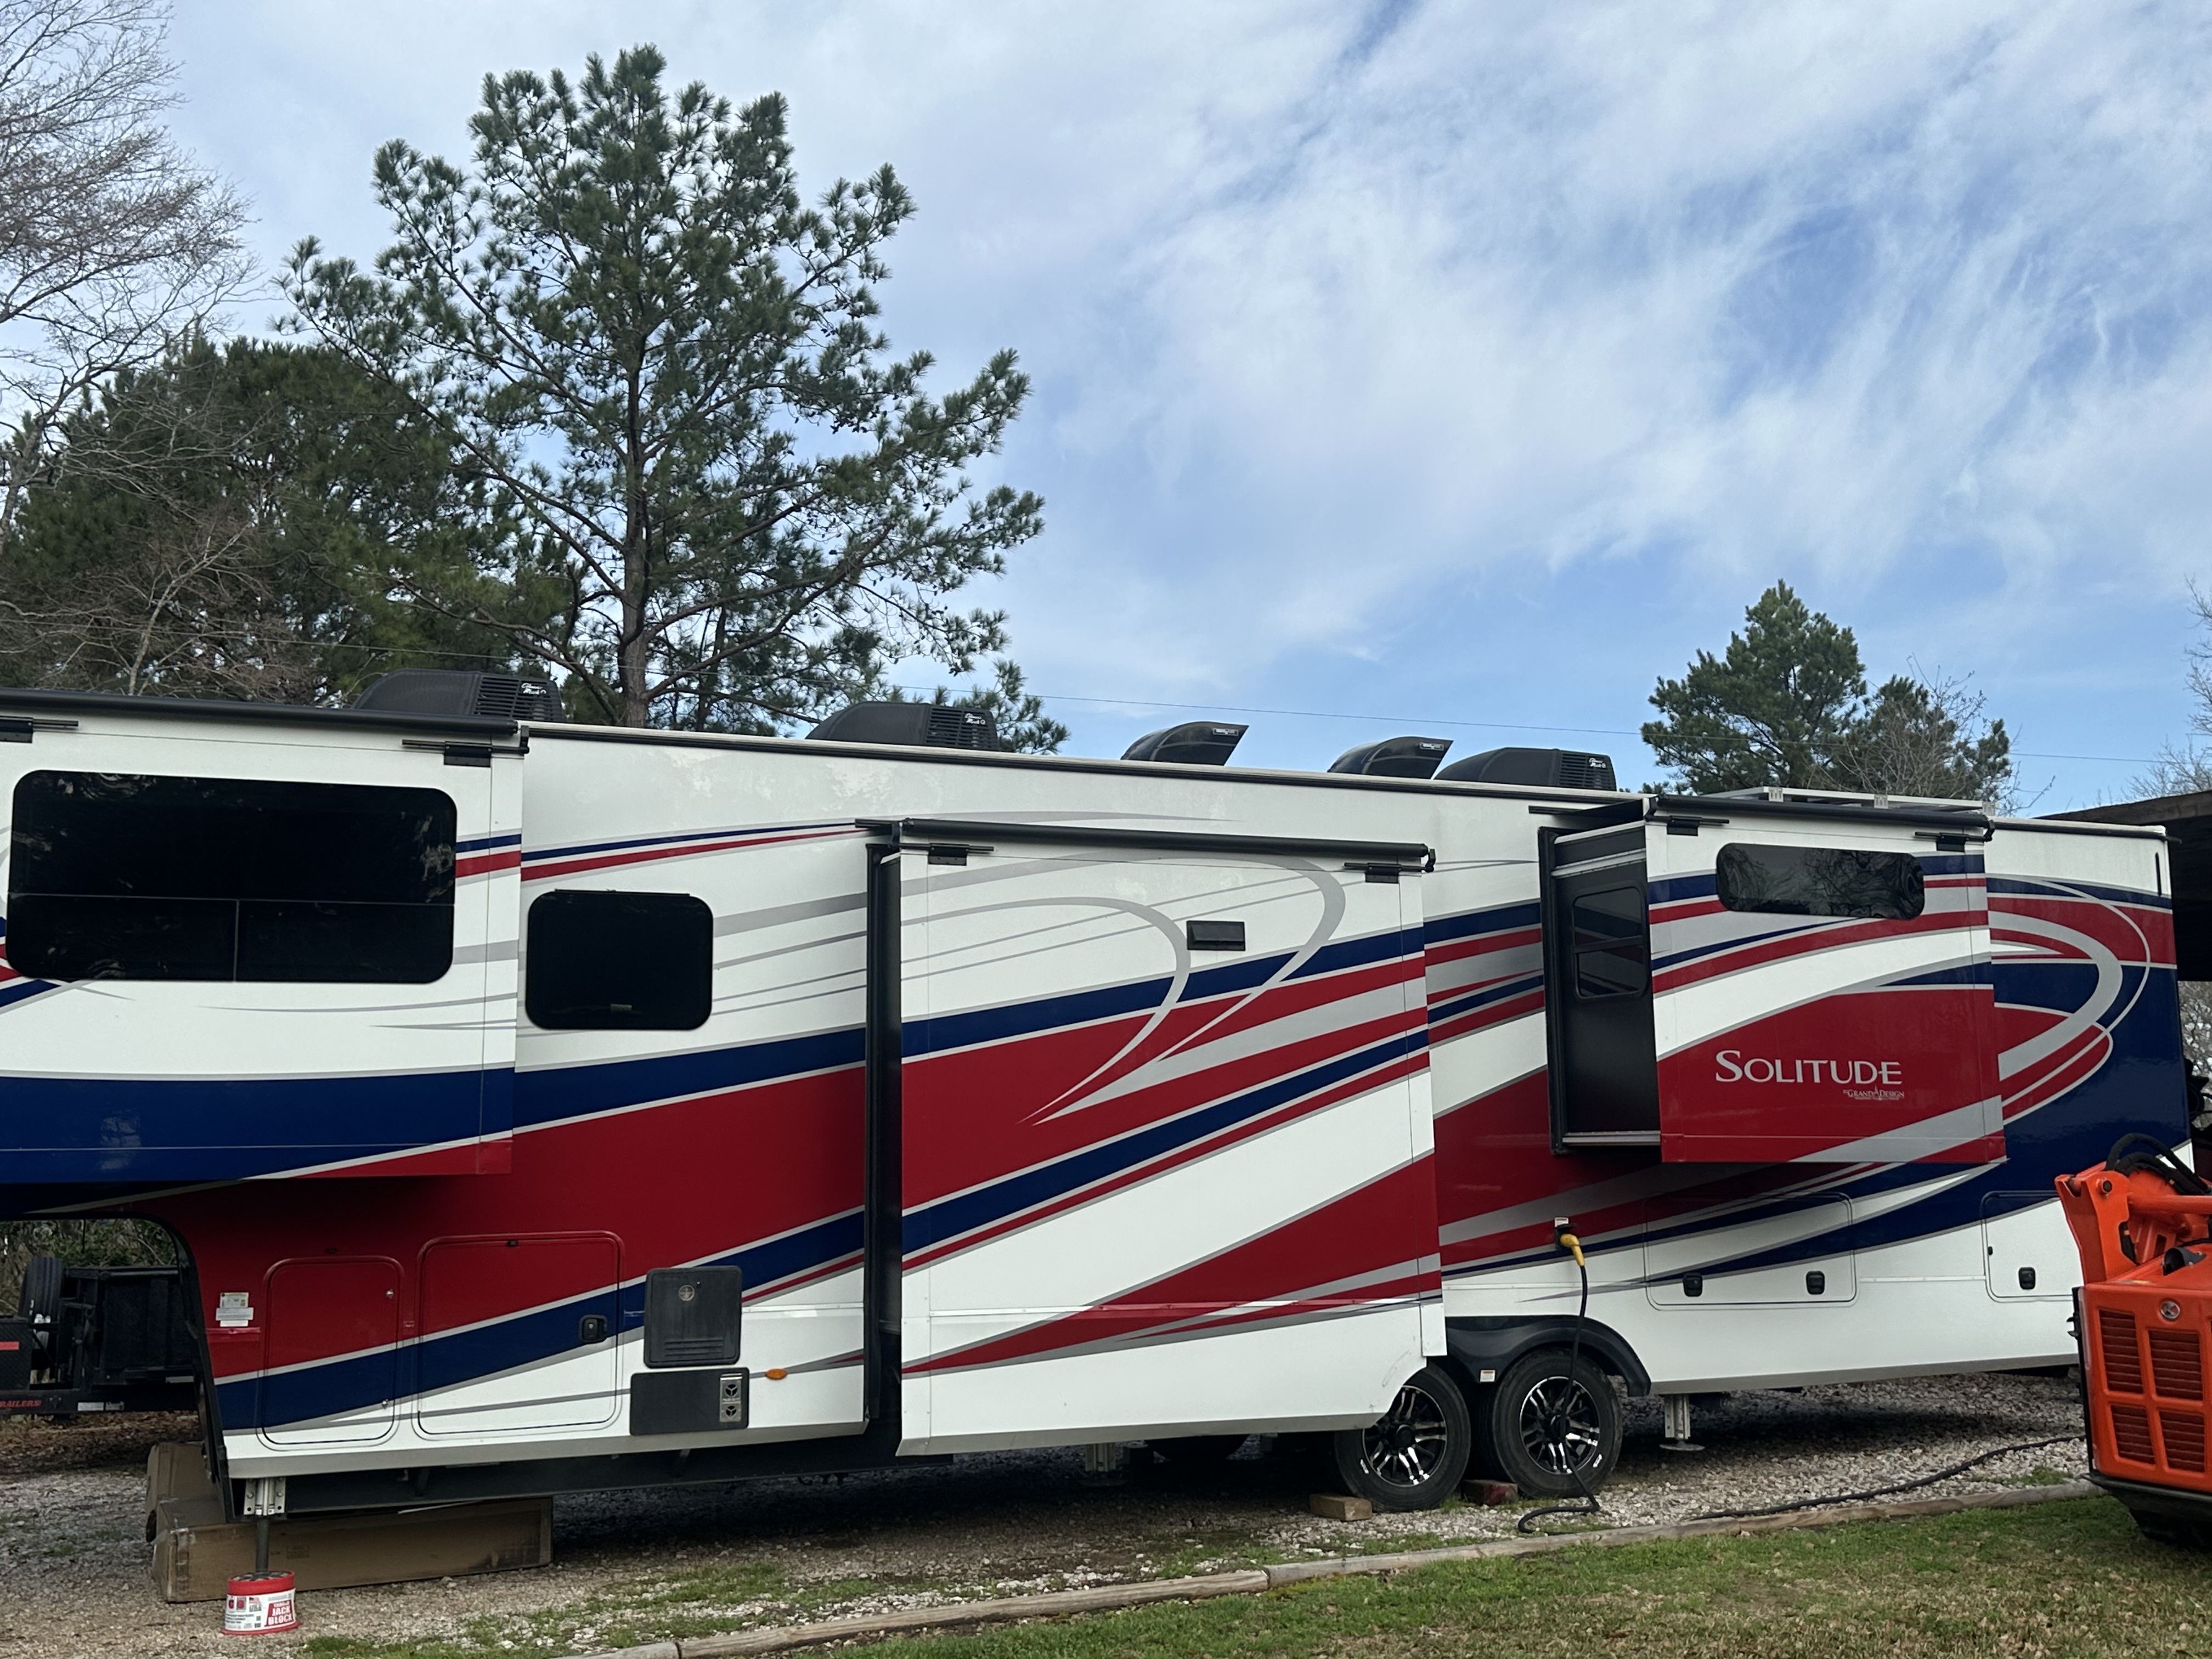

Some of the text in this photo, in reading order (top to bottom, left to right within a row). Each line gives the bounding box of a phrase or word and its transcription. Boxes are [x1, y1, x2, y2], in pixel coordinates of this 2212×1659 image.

[1716, 1050, 1902, 1084] SOLITUDE
[1847, 1089, 1874, 1098] GRAND
[1879, 1089, 1905, 1098] DESIGN
[272, 1605, 291, 1616] JACK
